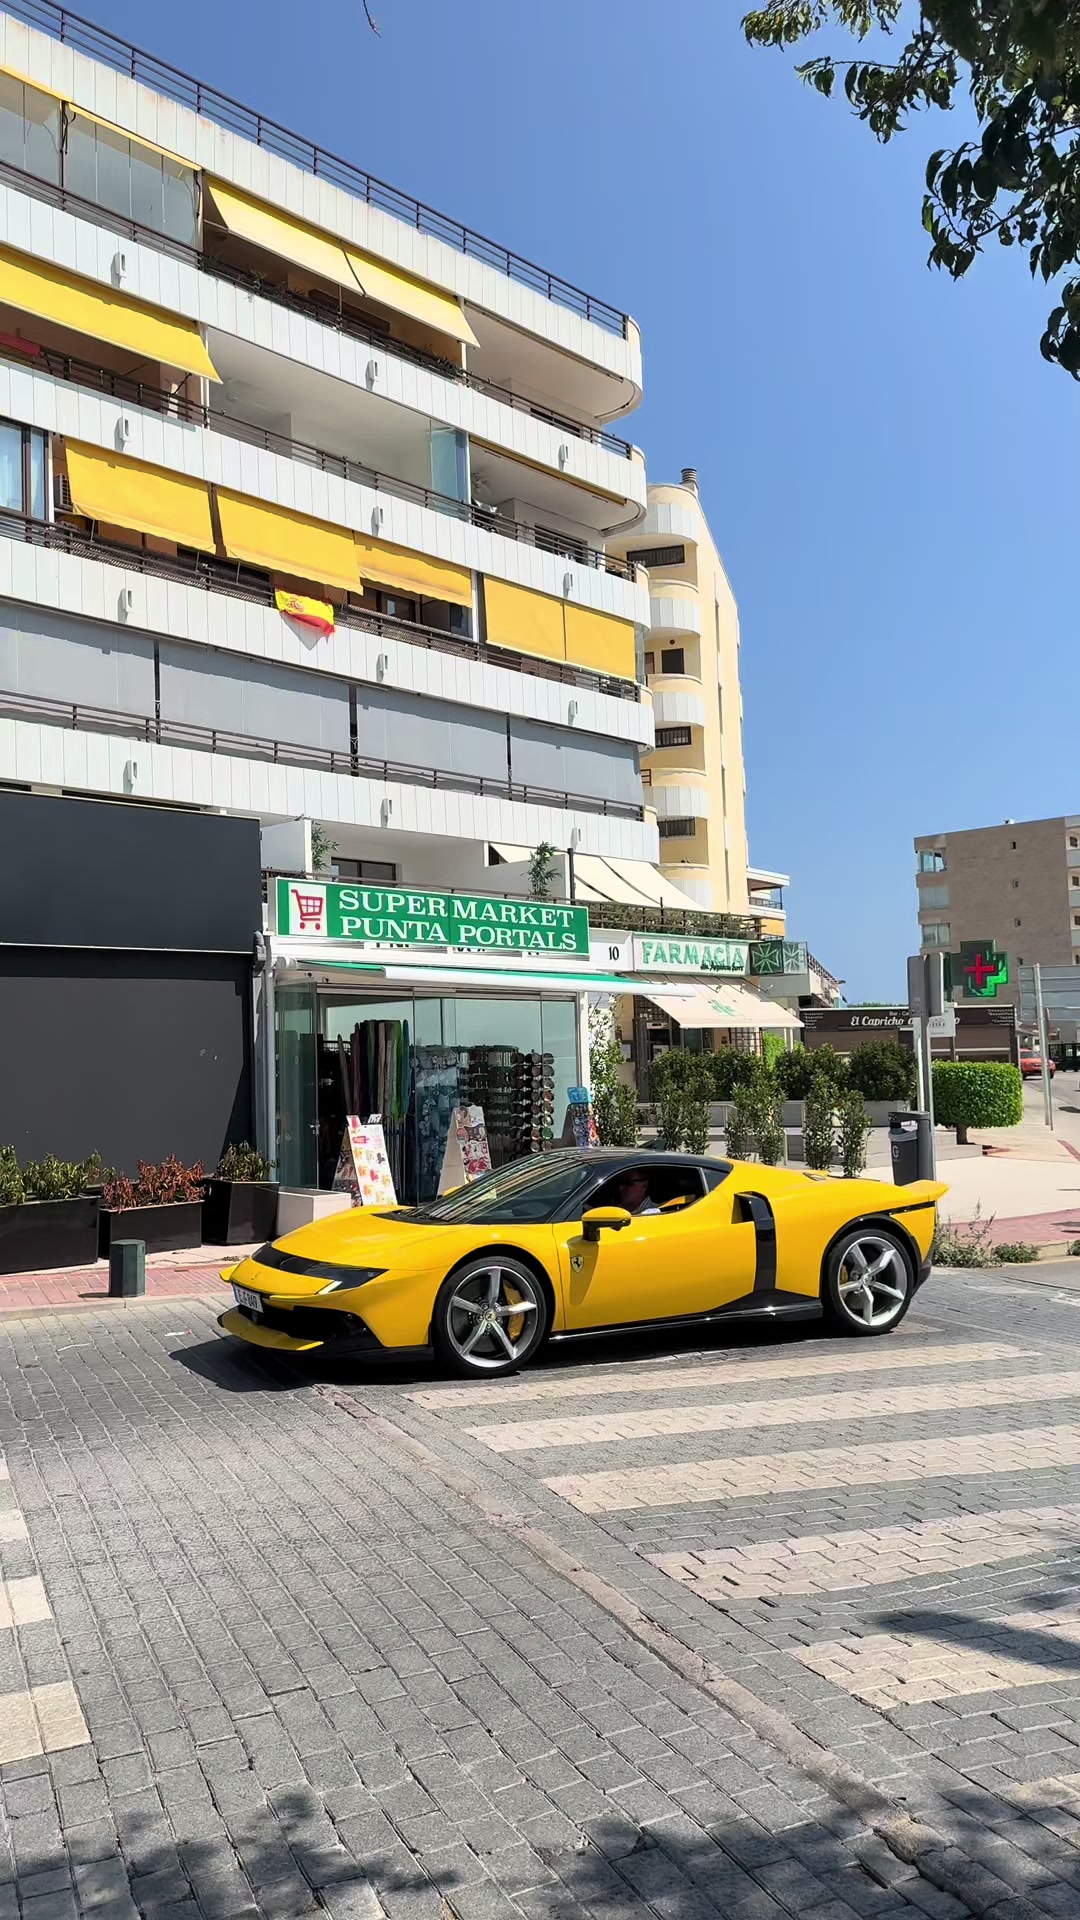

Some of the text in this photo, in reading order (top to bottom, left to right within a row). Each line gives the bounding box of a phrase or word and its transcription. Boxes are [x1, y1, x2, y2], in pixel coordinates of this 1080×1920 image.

[339, 889, 574, 928] SUPER MARKET
[339, 916, 577, 950] PUNTA PORTALS
[608, 945, 620, 961] 10
[850, 1015, 860, 1026] El
[861, 1015, 905, 1026] Capricho
